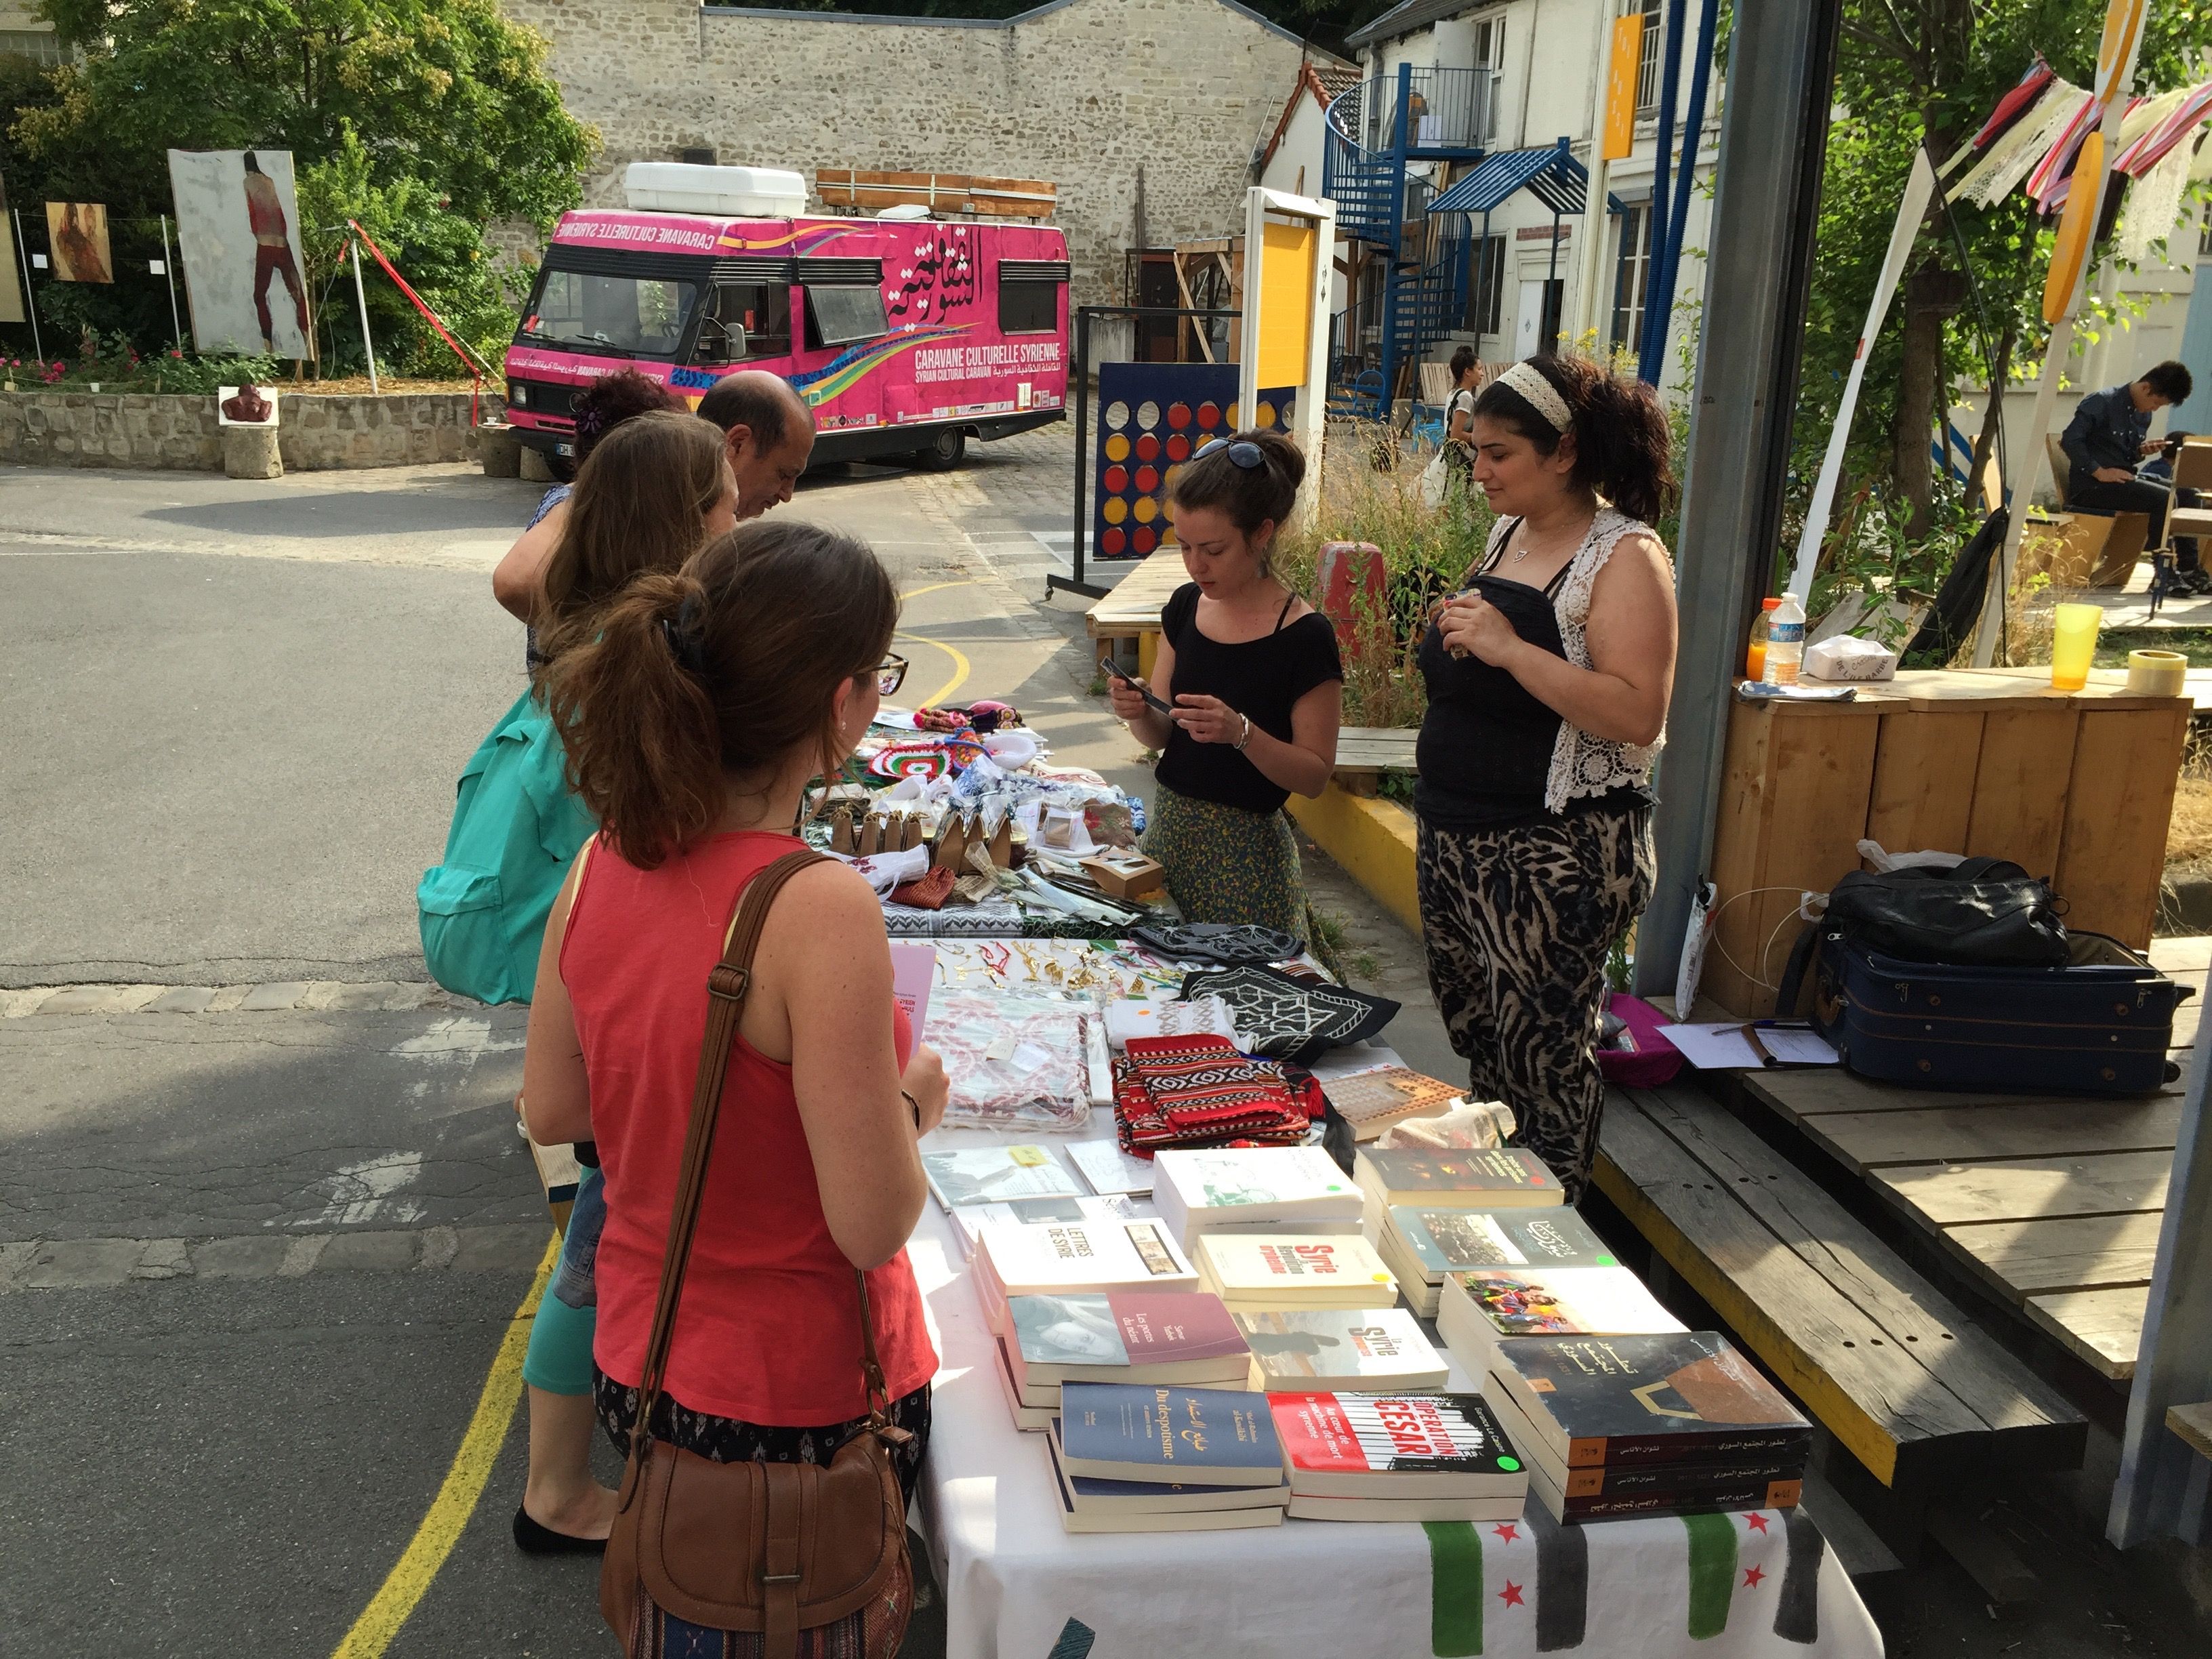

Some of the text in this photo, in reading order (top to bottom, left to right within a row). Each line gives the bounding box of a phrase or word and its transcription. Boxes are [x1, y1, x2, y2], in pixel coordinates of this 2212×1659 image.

[915, 342, 1061, 370] CARAVANE CULTURELLE SYRIENNE
[1017, 364, 1041, 376] الثقافية
[916, 367, 991, 384] SYRIAN CULTURAL CARAVAN
[993, 365, 1017, 378] السورية
[1048, 1228, 1076, 1259] DE SYRIE
[1067, 1227, 1094, 1258] LETTRES
[1276, 1245, 1305, 1275] Révolution
[1294, 1245, 1339, 1274] Syrie
[1122, 1317, 1141, 1345] du néant
[1136, 1312, 1155, 1343] Les portes
[1348, 1327, 1400, 1356] Syrie
[1557, 1343, 1597, 1375] السوري
[1577, 1343, 1617, 1375] المجتمع
[1155, 1389, 1176, 1460] Du despotisme
[1298, 1409, 1319, 1439] syrienne
[1308, 1402, 1328, 1429] machine
[1324, 1407, 1351, 1445] Au cœur de
[1322, 1430, 1334, 1439] de
[1718, 1441, 1742, 1451] السوري
[1743, 1439, 1766, 1450] المجتمع
[1326, 1440, 1343, 1459] mort
[1713, 1469, 1737, 1479] السوري
[1737, 1468, 1761, 1478] المجتمع
